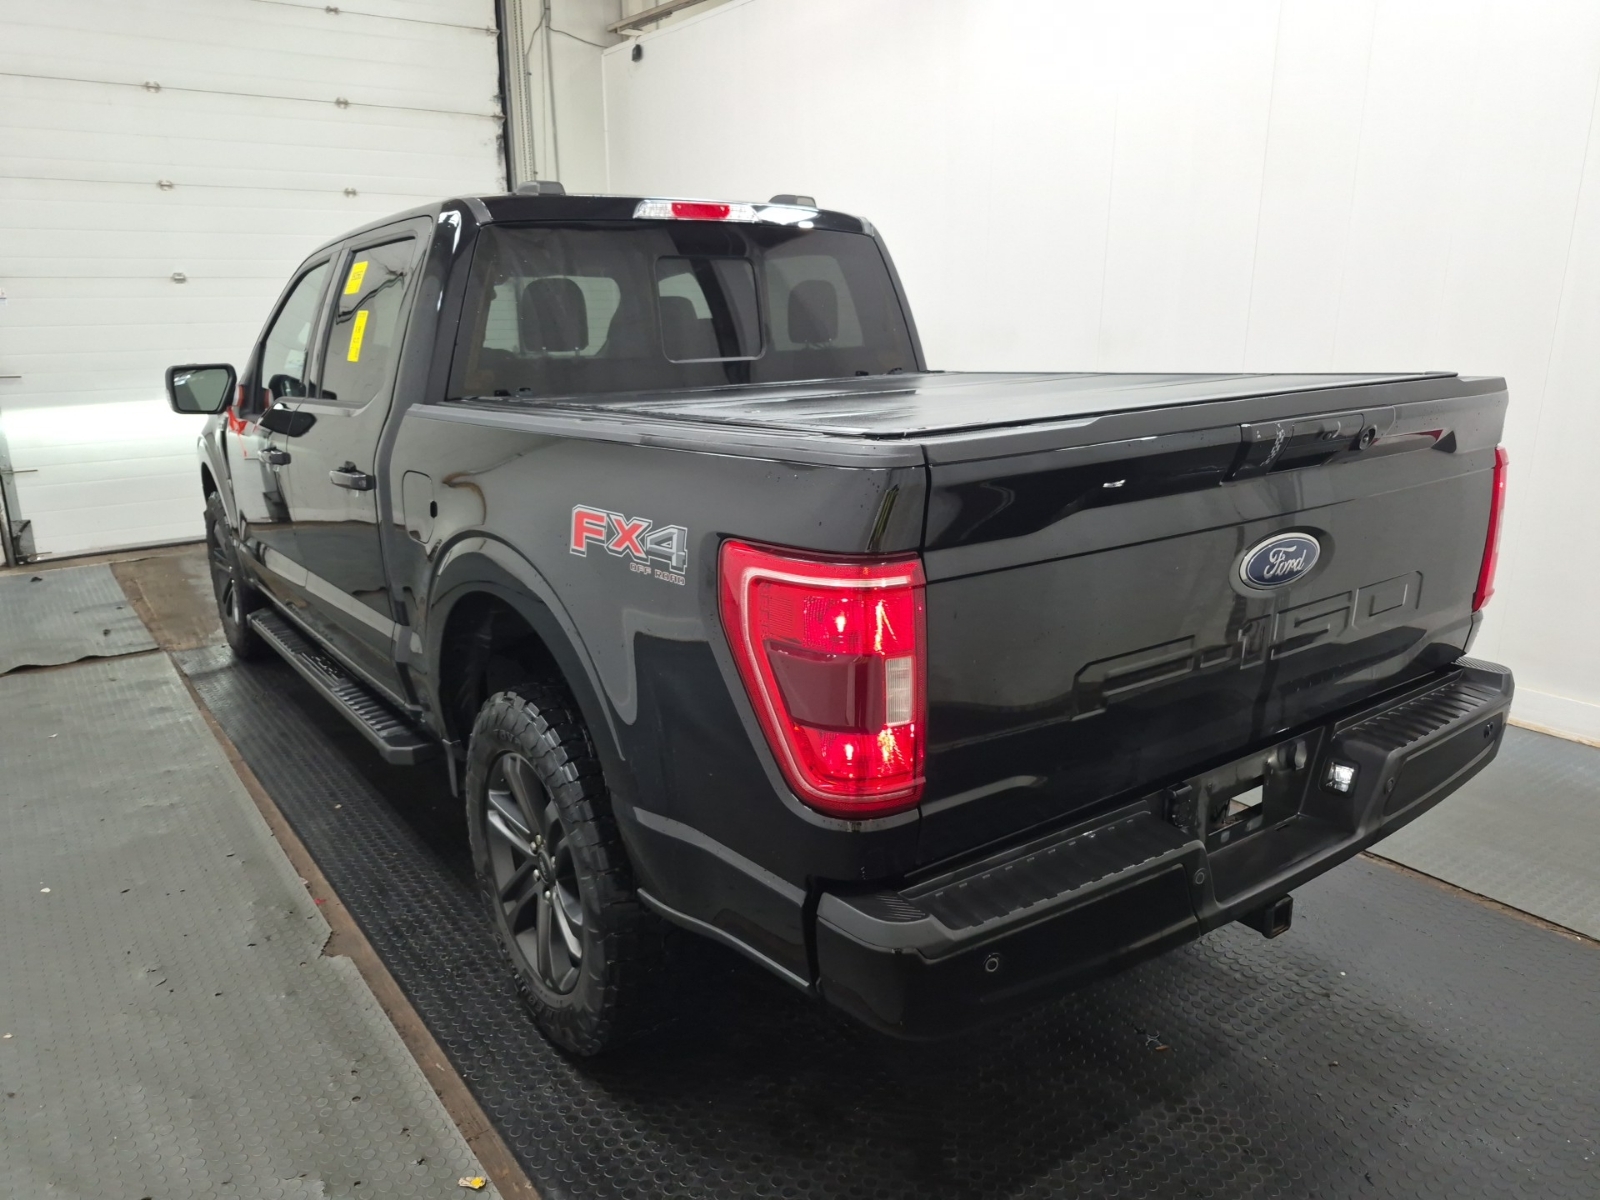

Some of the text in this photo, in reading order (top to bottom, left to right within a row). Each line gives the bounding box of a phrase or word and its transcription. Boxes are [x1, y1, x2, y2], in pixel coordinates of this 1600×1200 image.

[570, 504, 688, 575] FX4
[629, 562, 686, 586] OFF ROAD
[1263, 545, 1307, 579] Ford
